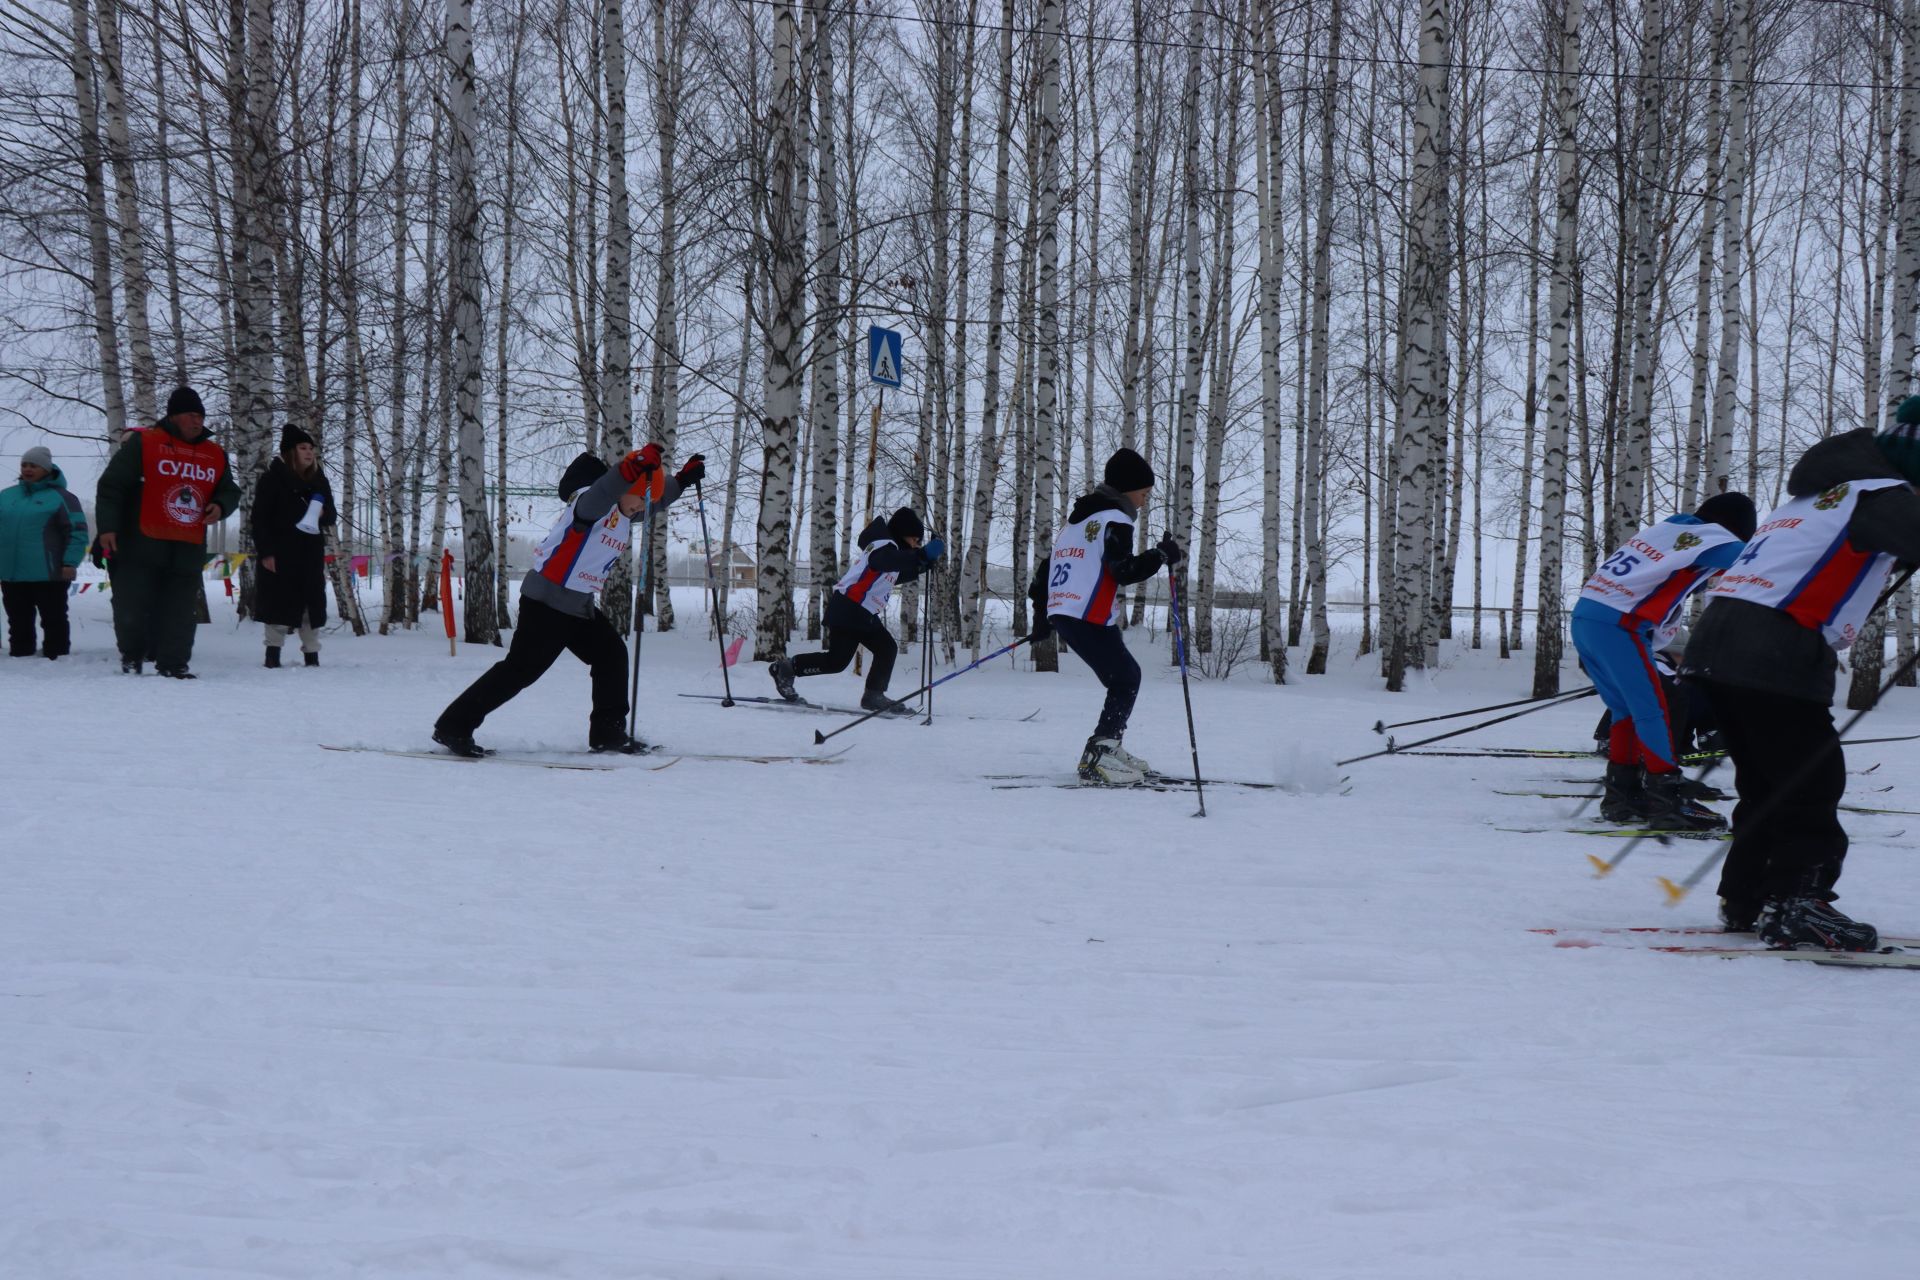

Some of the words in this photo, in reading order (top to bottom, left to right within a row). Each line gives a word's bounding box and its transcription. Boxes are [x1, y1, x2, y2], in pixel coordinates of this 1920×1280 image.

[158, 459, 216, 483] СУДЬЯ
[1050, 562, 1072, 587] 26
[1600, 550, 1641, 577] 25
